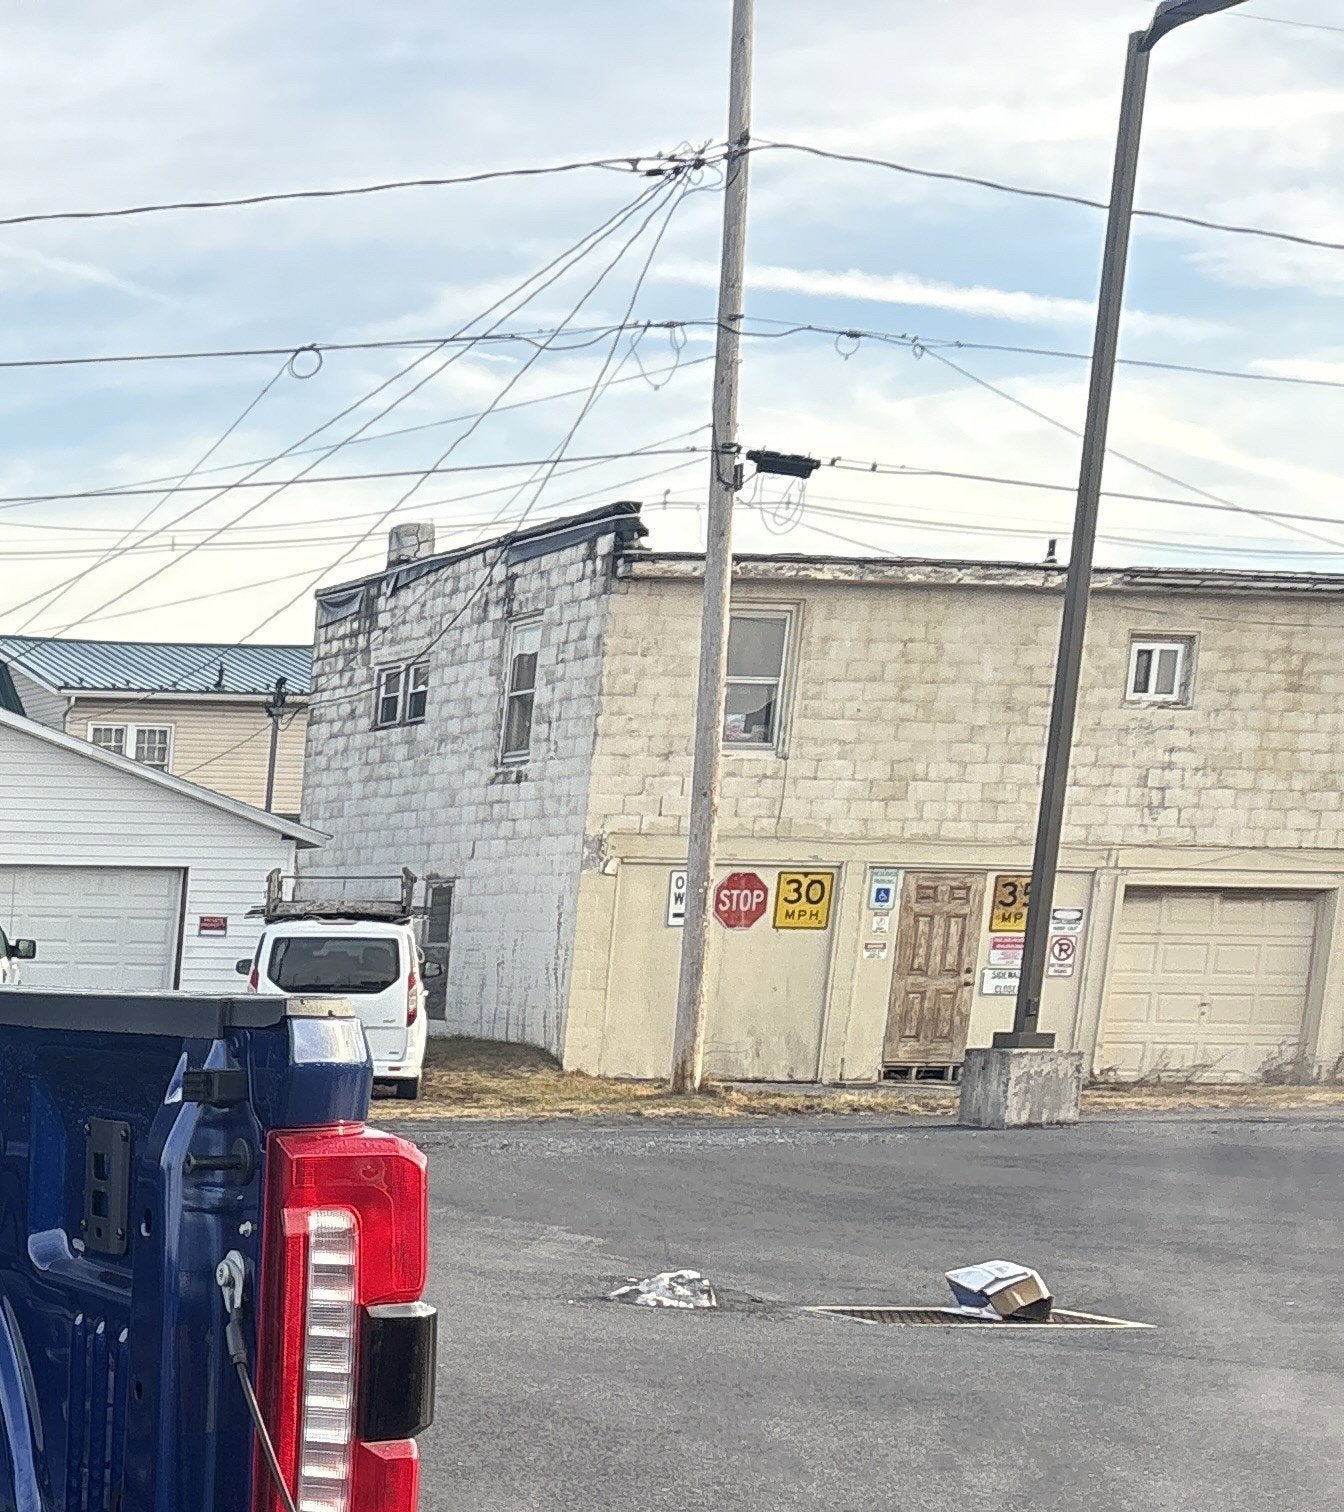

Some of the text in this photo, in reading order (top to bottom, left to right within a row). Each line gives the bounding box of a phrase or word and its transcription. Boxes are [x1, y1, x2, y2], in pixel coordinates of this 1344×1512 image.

[783, 878, 826, 905] 30
[718, 889, 765, 912] STOP
[784, 909, 820, 920] MPH
[1001, 912, 1024, 924] MP
